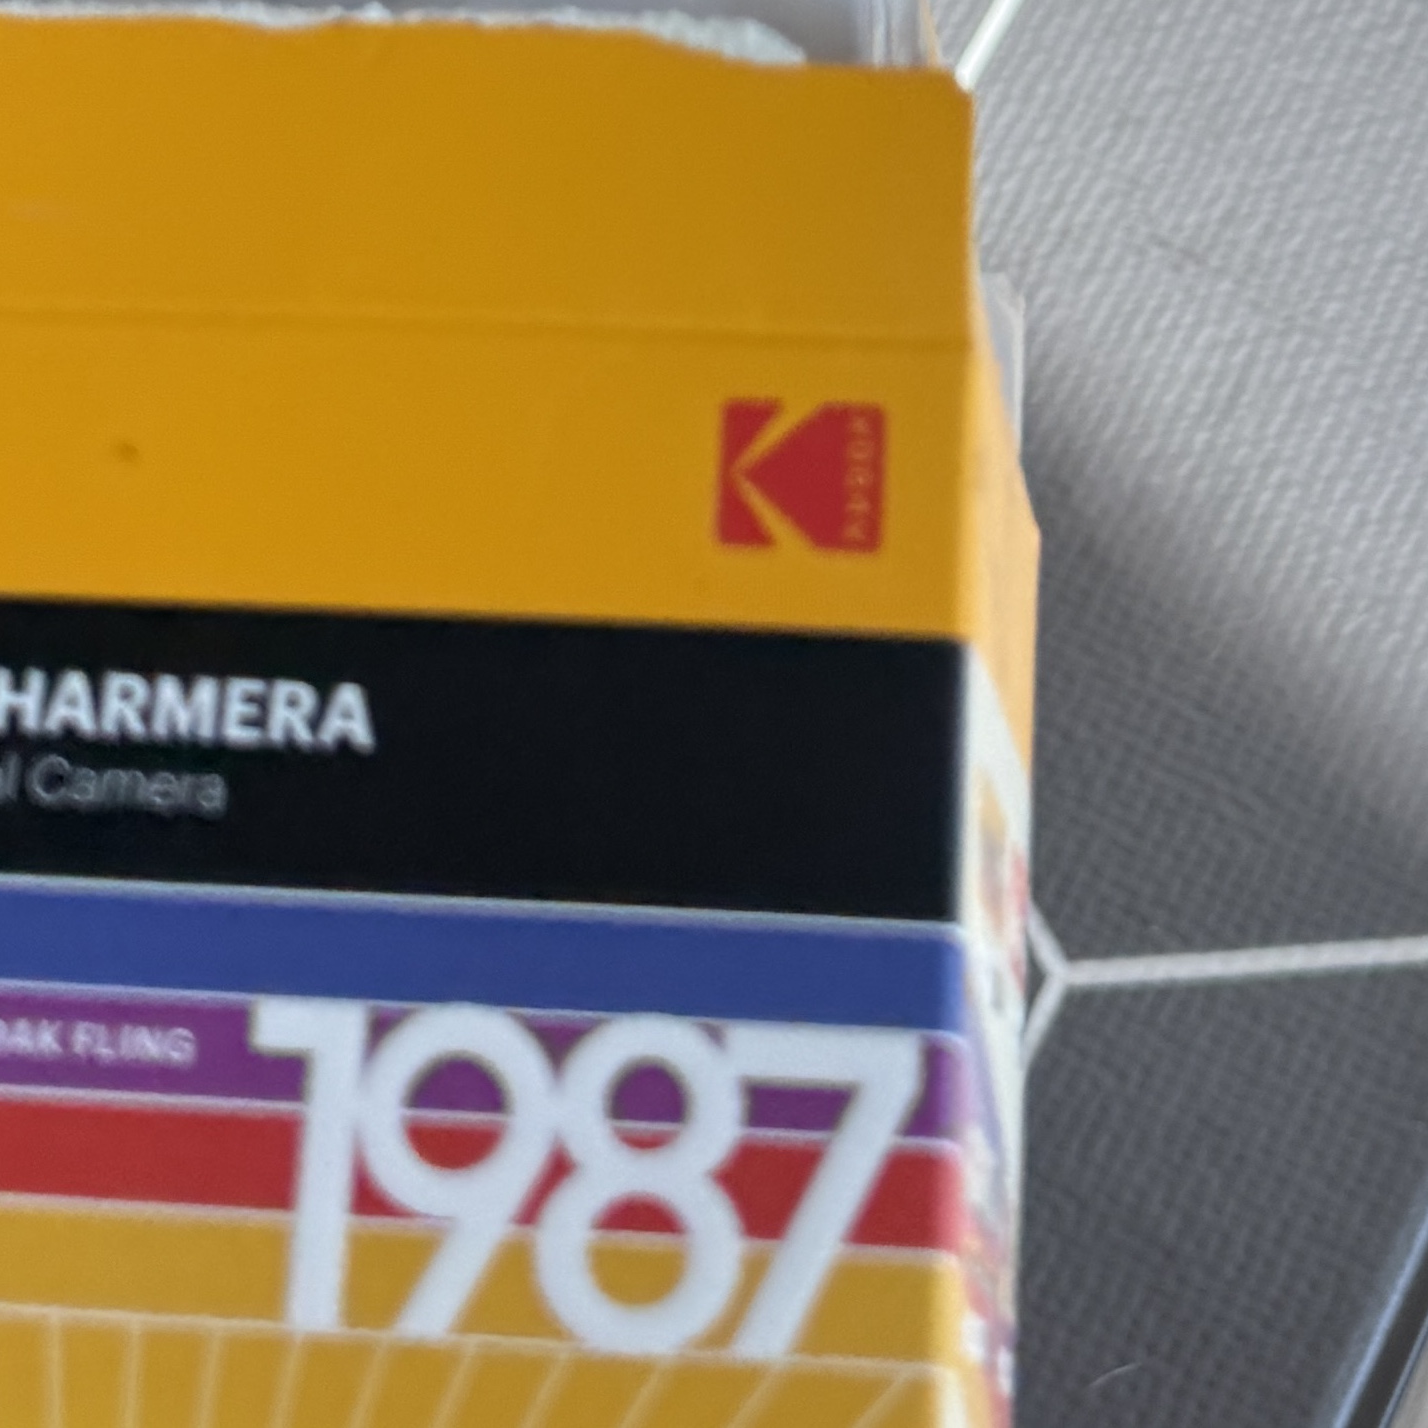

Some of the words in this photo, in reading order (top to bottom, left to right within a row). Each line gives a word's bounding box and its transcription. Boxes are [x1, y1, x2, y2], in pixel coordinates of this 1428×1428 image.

[26, 755, 230, 819] Camera
[69, 1020, 199, 1066] FLING
[248, 996, 926, 1364] 1987
